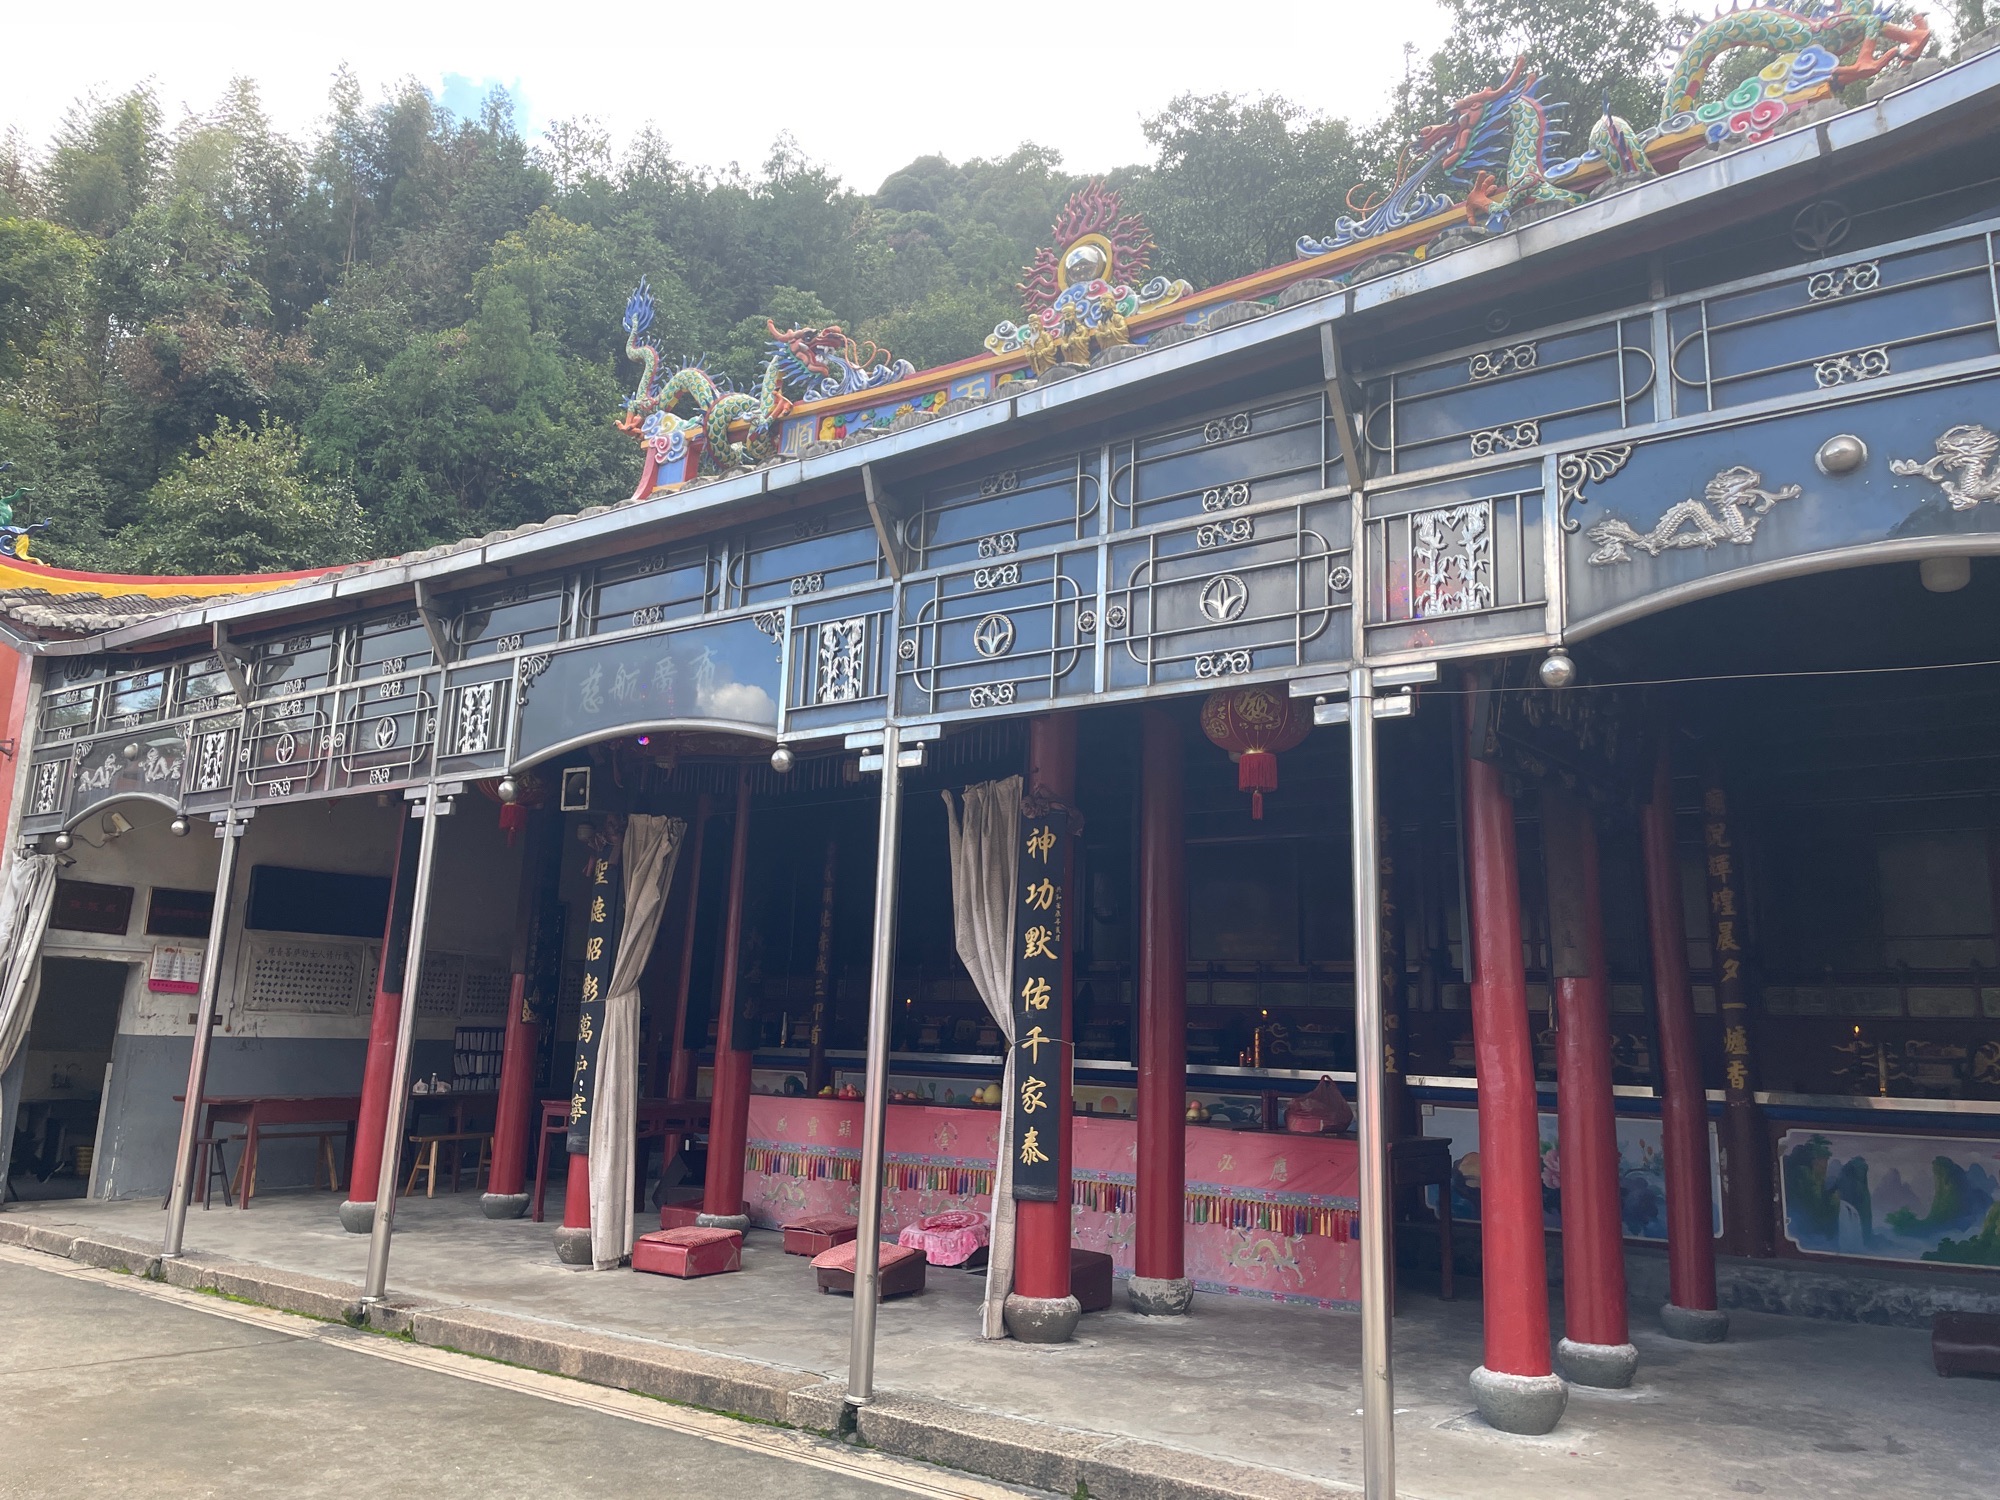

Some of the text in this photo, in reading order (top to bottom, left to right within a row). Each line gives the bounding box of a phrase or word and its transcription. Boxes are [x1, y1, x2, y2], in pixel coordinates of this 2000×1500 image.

[1019, 827, 1059, 1167] 神功默佑千家泰
